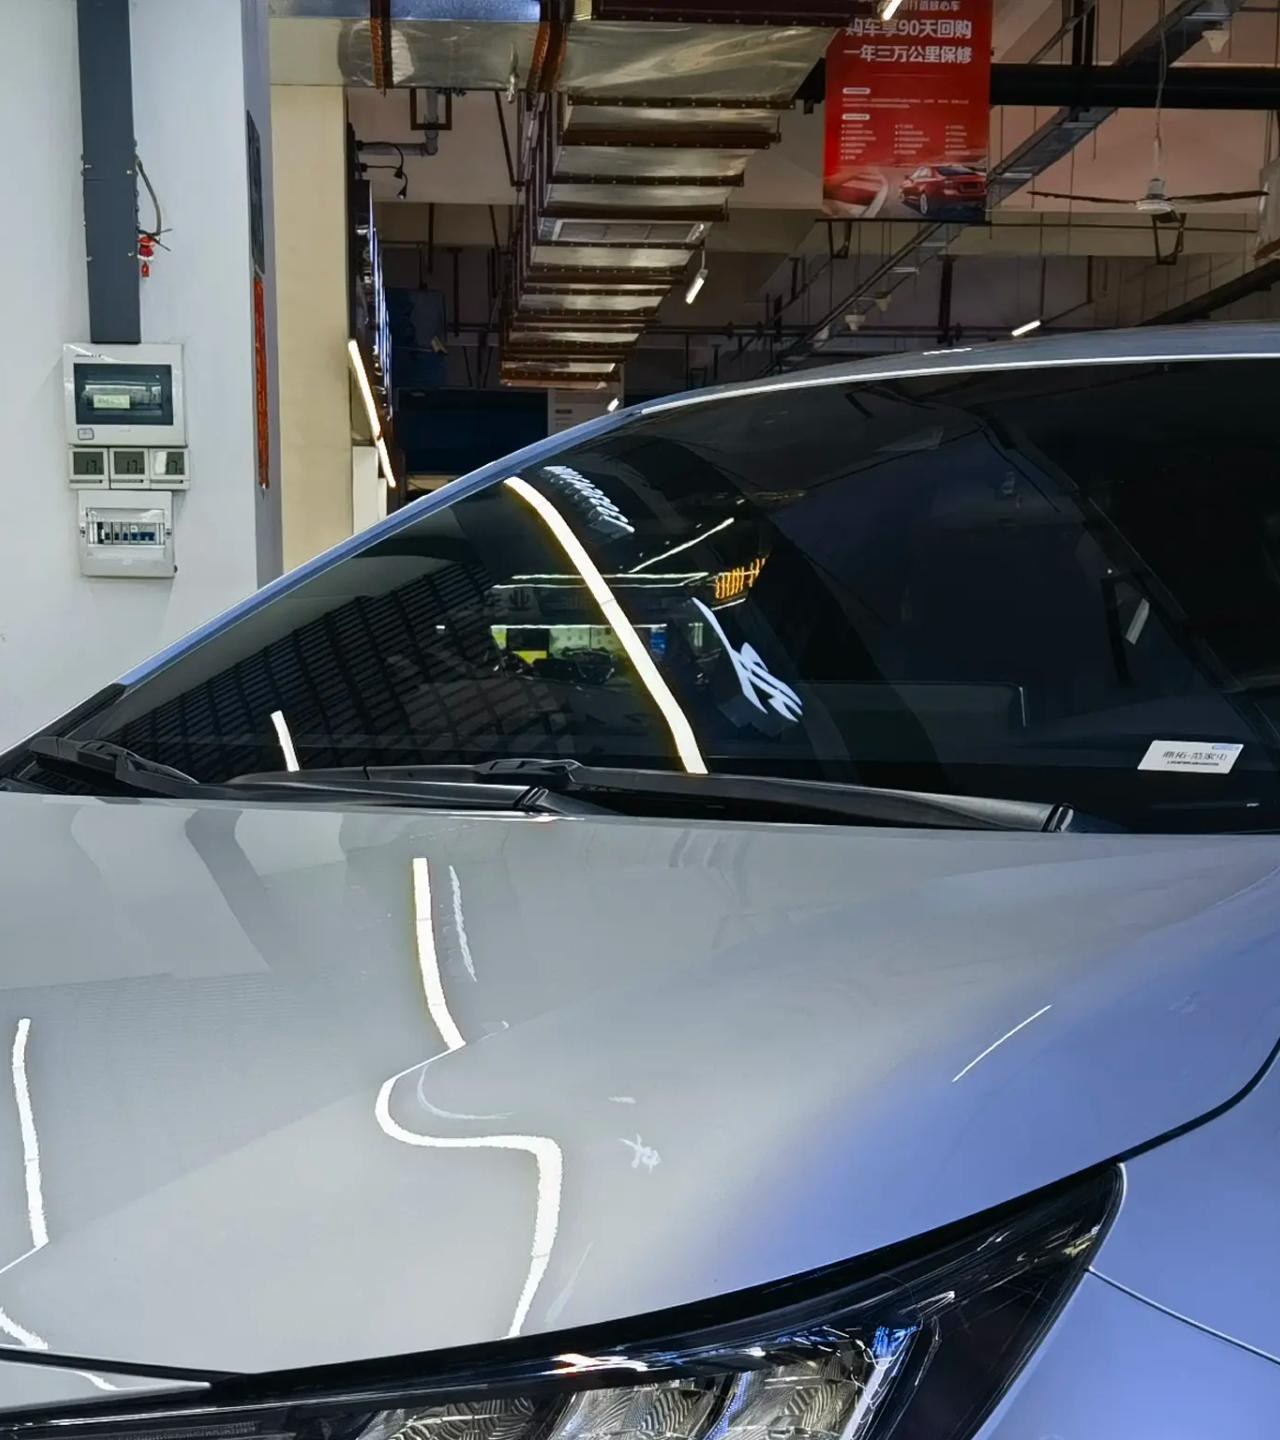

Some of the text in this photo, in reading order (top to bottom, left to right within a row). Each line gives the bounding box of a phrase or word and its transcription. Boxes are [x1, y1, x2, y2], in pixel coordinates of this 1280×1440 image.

[843, 45, 972, 64] 一年三万公里保修
